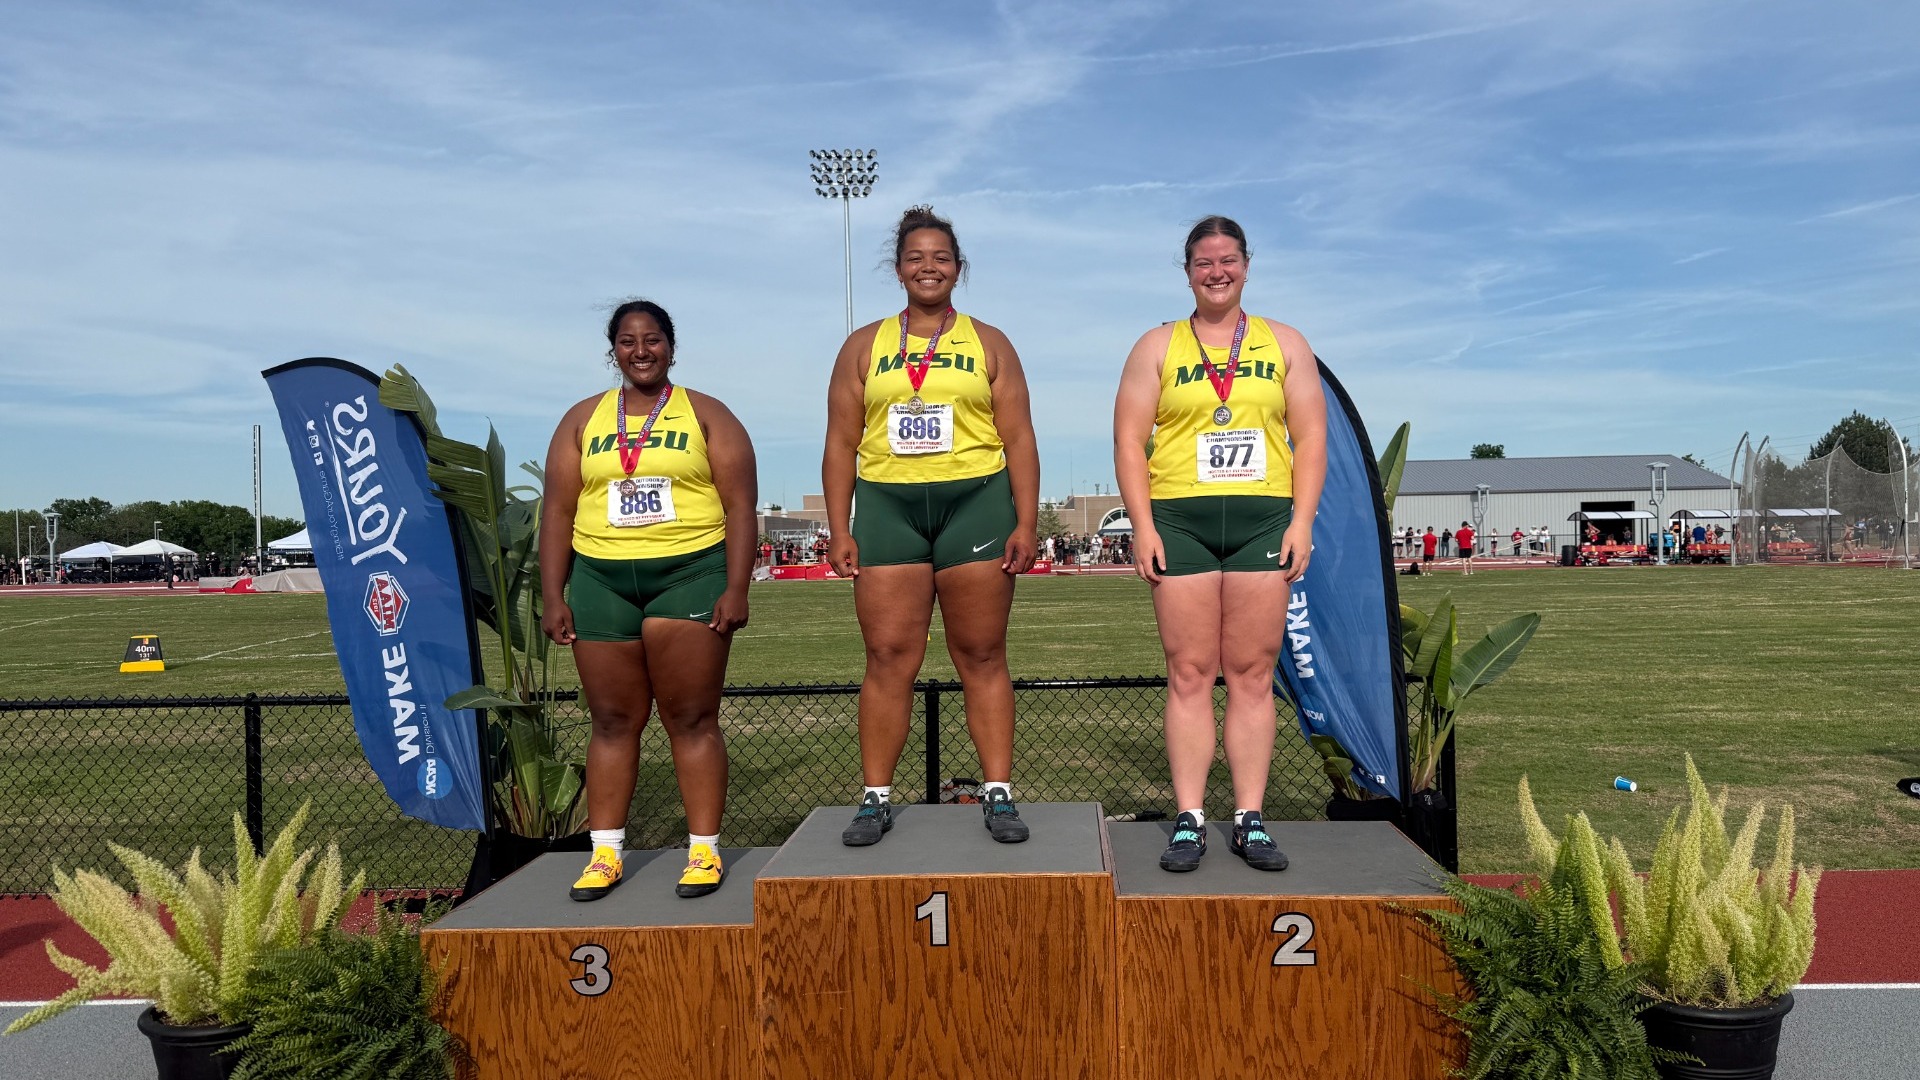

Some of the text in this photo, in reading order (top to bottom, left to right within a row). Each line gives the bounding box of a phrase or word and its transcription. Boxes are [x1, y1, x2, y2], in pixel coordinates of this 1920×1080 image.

[874, 352, 975, 377] MSSU
[898, 416, 941, 441] 896
[1209, 443, 1254, 469] 877
[620, 489, 663, 516] 886
[135, 645, 156, 653] 40m
[1172, 830, 1201, 843] NIKE
[1247, 830, 1272, 843] NIKE
[915, 890, 949, 947] 1
[1270, 911, 1317, 967] 2
[569, 943, 613, 997] 3
